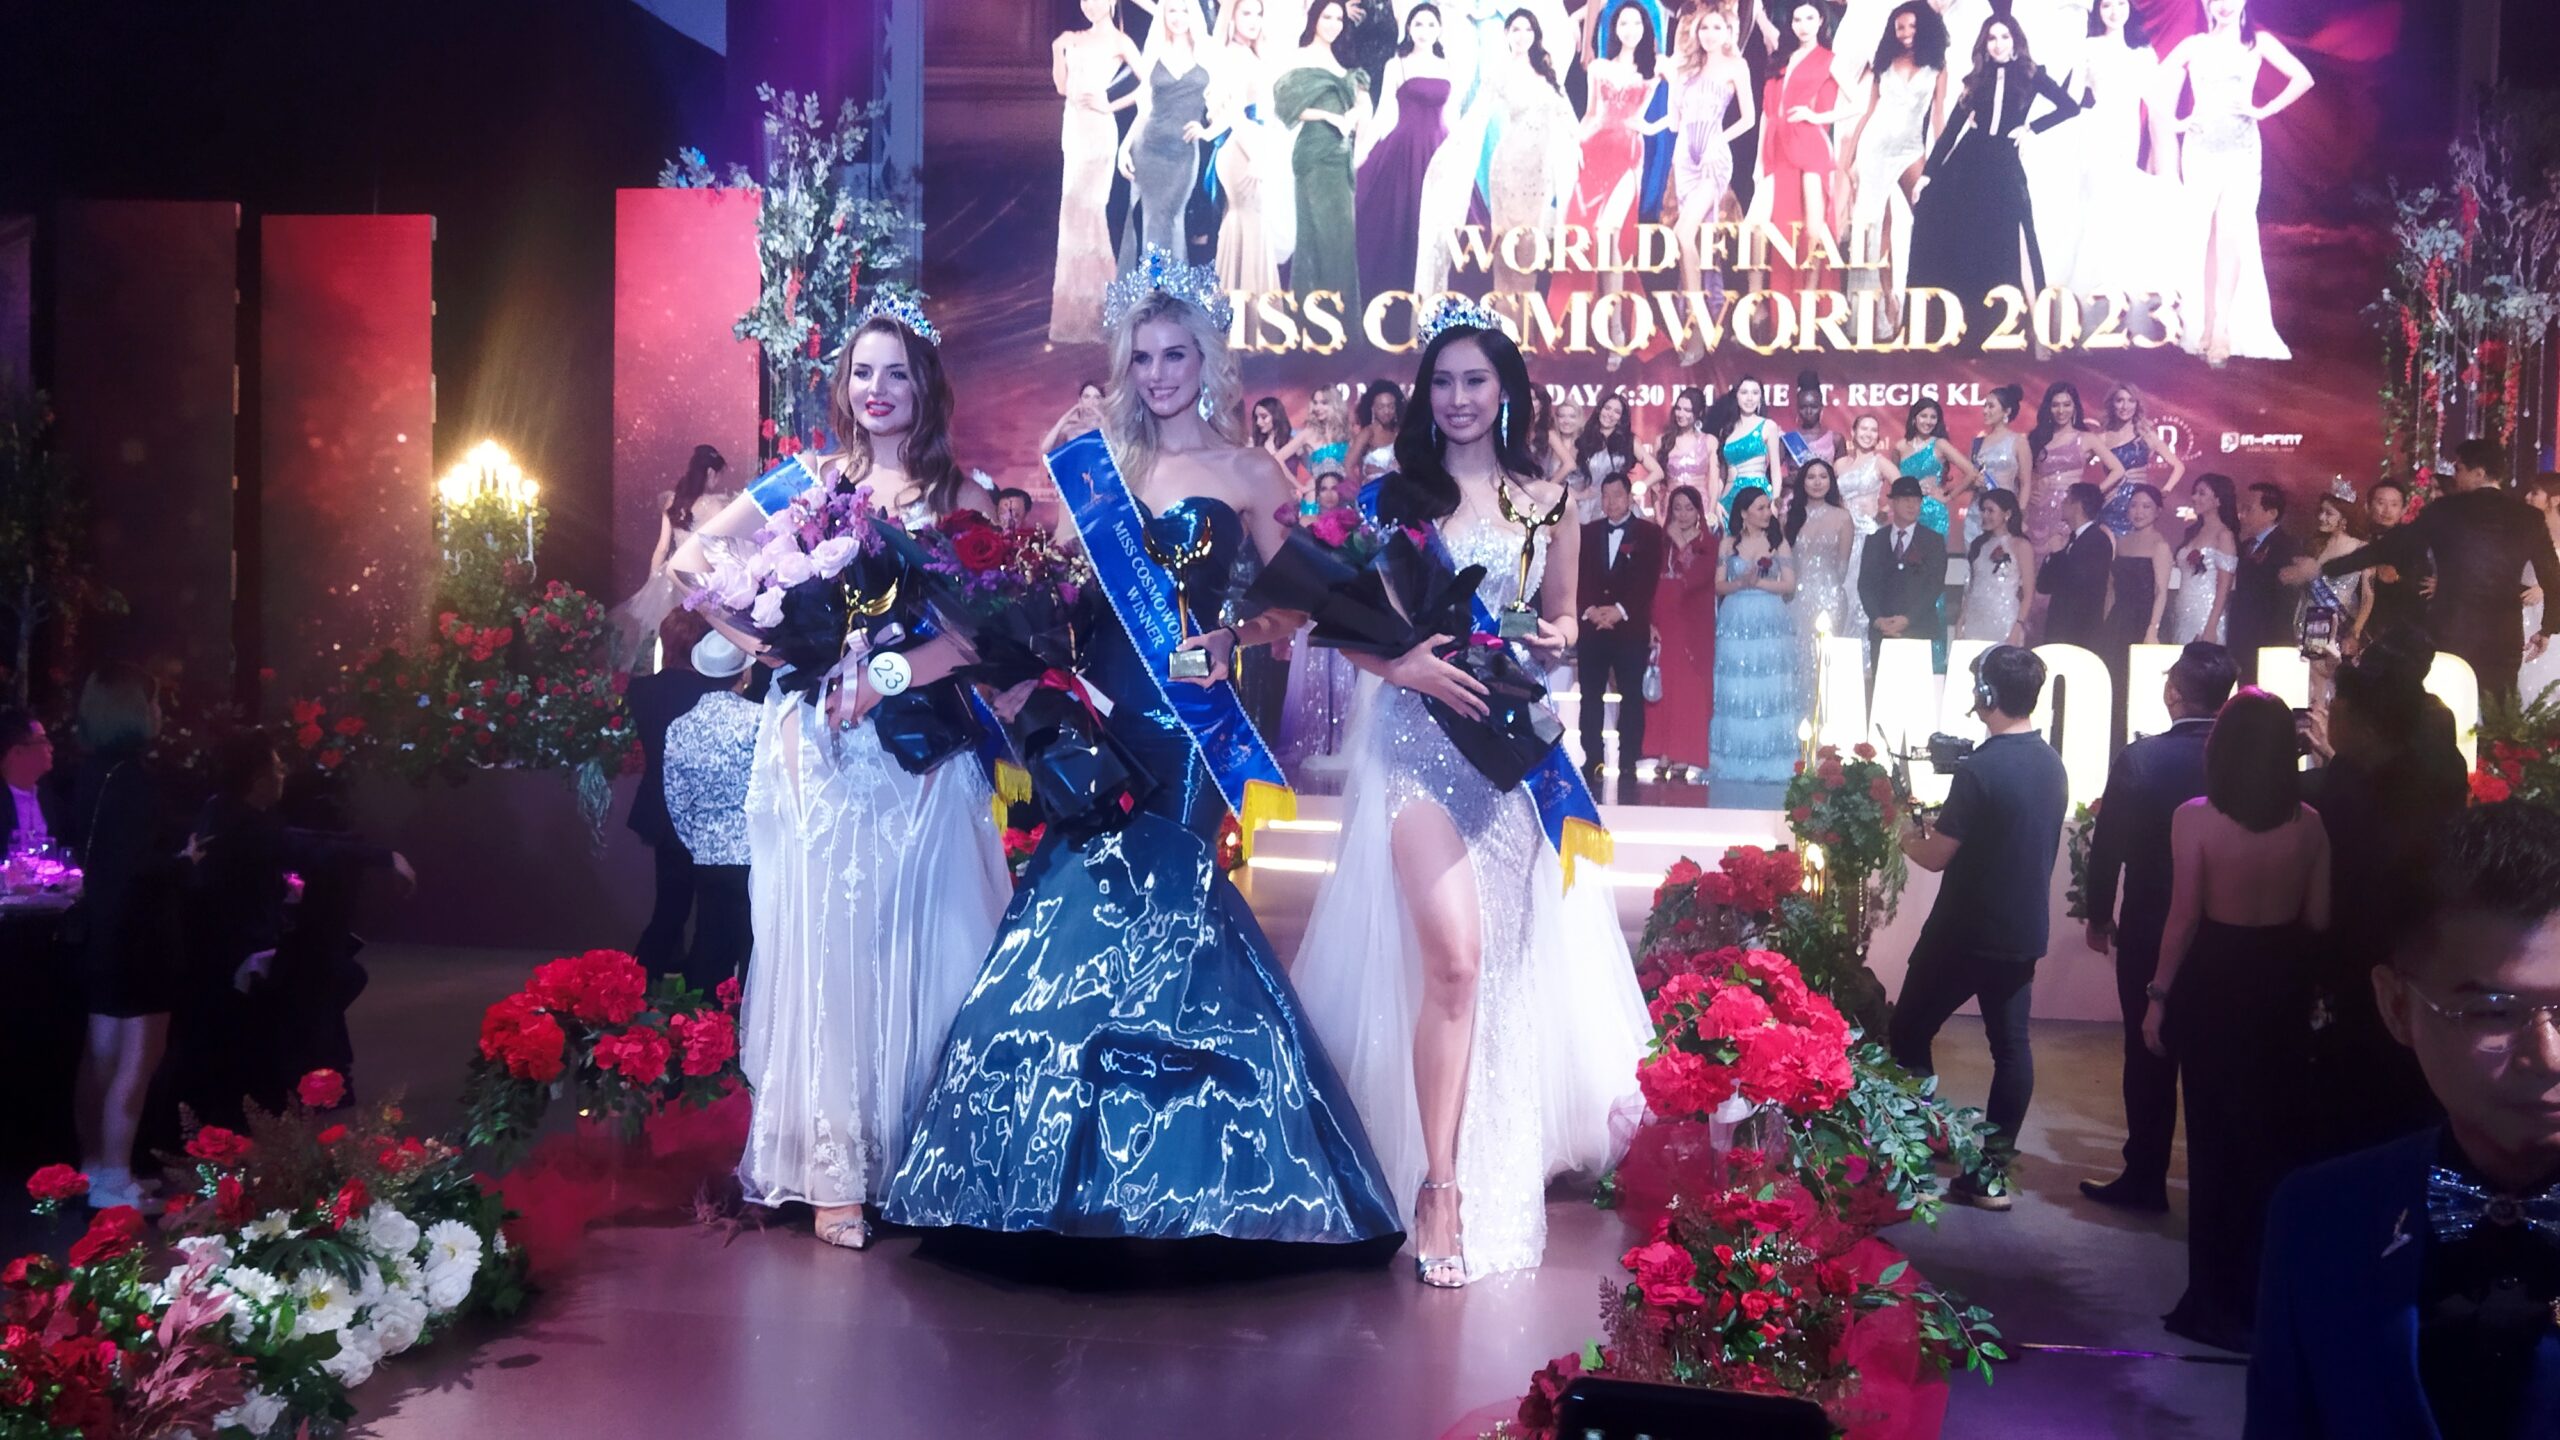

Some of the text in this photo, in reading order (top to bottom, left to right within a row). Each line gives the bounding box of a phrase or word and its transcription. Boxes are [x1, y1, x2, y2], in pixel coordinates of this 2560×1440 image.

[1450, 221, 1891, 274] WORLD FINAL
[1226, 288, 1348, 355] ISS
[1981, 284, 2184, 353] 2023
[1545, 383, 1604, 407] DAY
[1797, 383, 1841, 407] T.
[1847, 383, 1940, 407] REGIS
[1945, 383, 1987, 407] KL
[1112, 520, 1183, 647] MISS COSMOWOR
[1126, 585, 1165, 649] WINNER
[873, 658, 904, 690] 23
